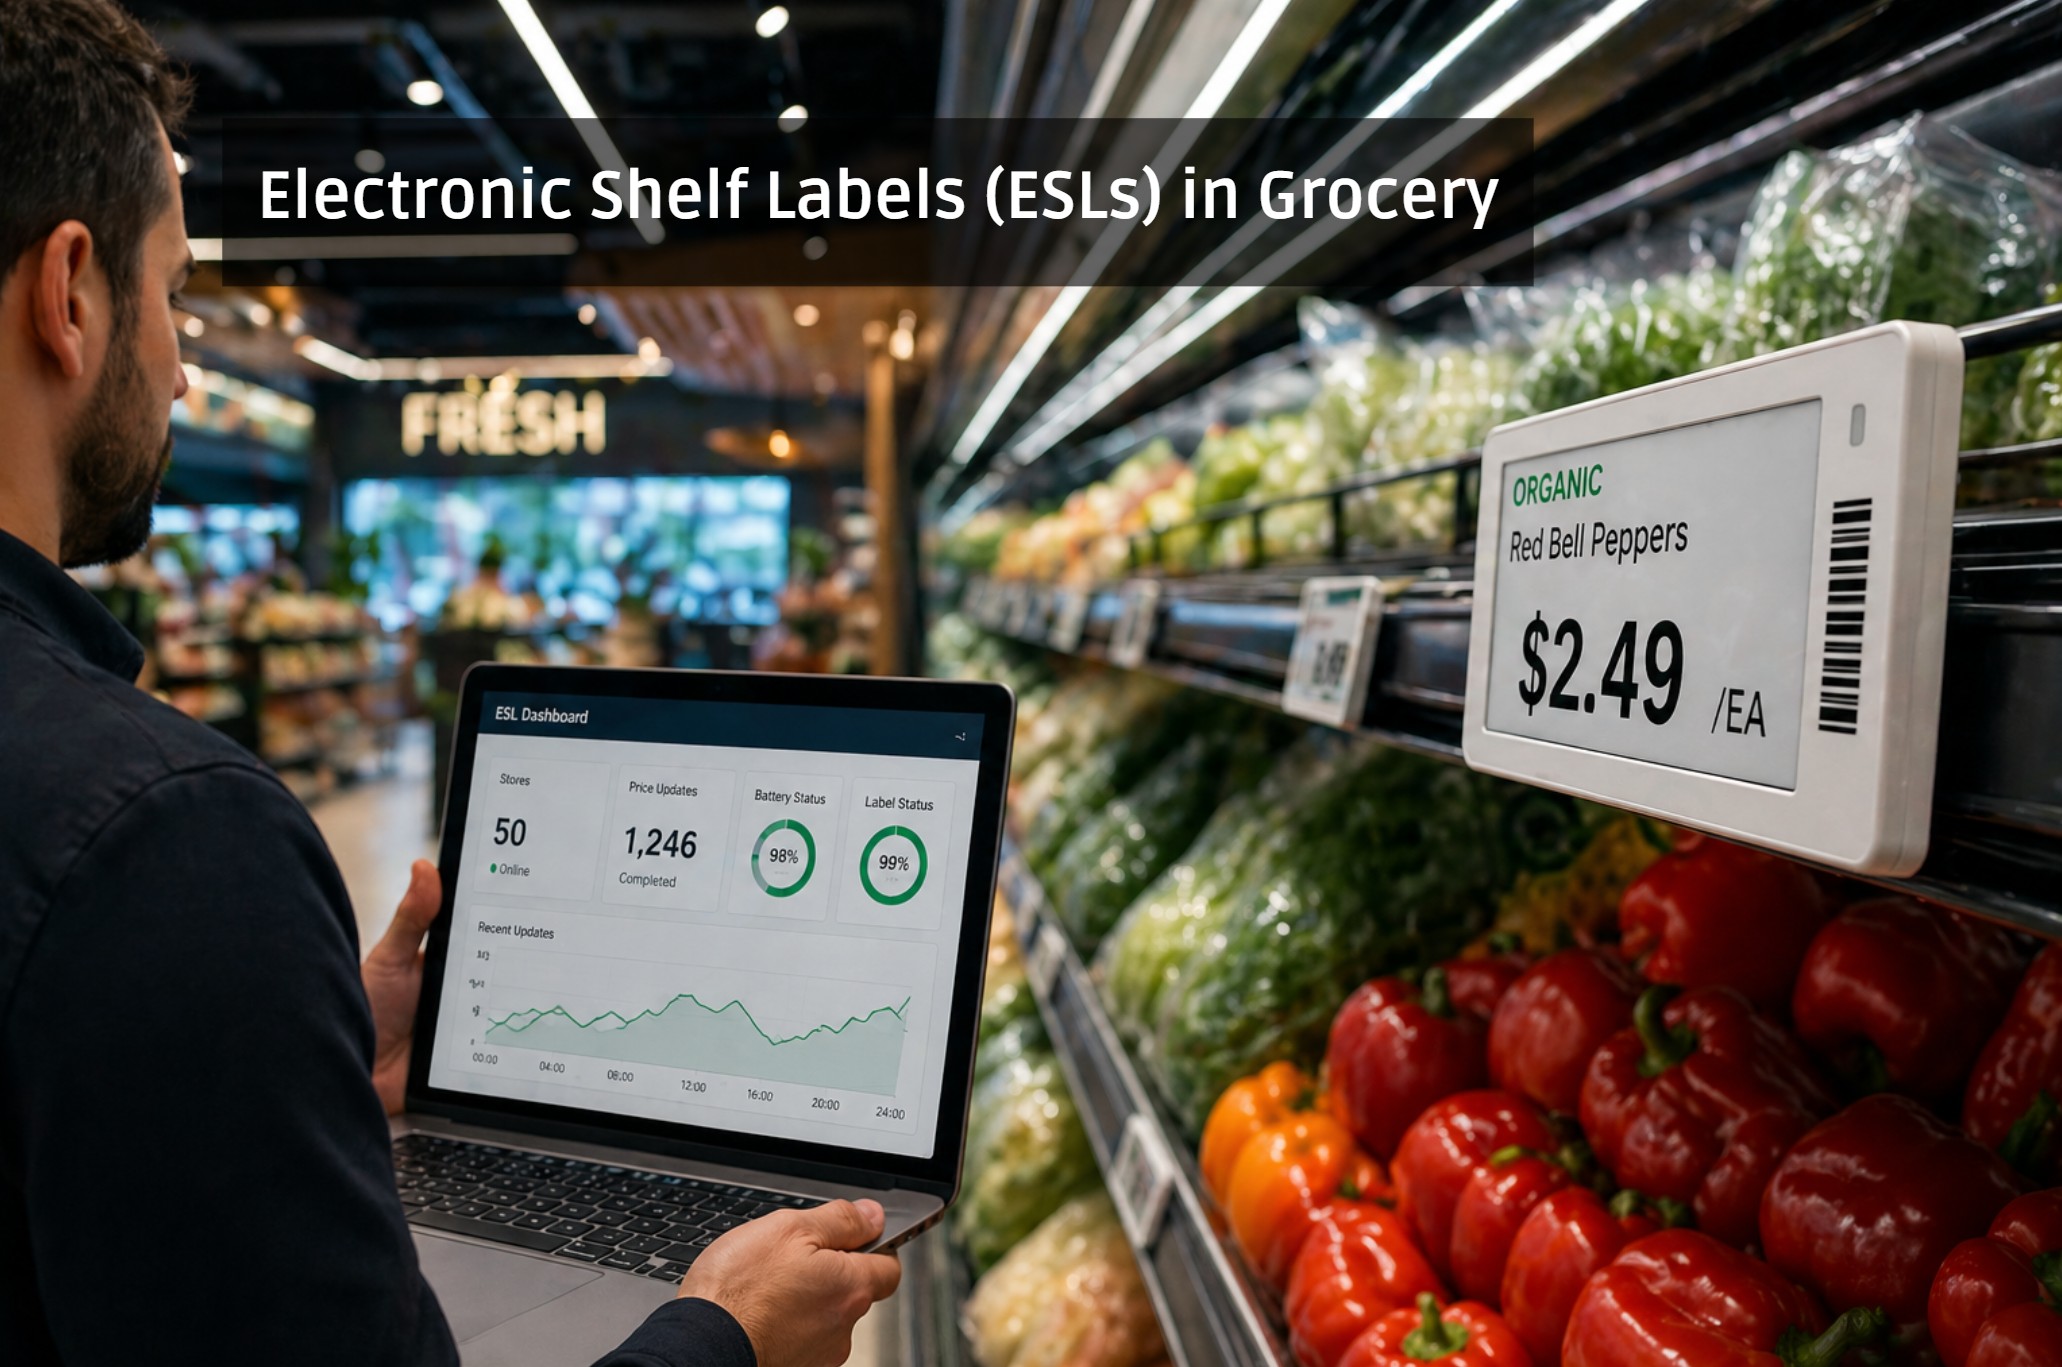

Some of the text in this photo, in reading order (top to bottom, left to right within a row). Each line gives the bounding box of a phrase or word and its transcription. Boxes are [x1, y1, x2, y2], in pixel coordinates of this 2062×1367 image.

[401, 392, 607, 457] FRESH
[1512, 464, 1604, 507] ORGANIC
[1509, 520, 1689, 566] Red Bell Peppers
[1518, 609, 1767, 738] $2.49 /EA
[495, 706, 589, 725] ESL Dashboard
[499, 772, 531, 787] Stores
[629, 780, 698, 799] Price Updates
[754, 788, 827, 806] Battery Status
[864, 795, 934, 812] Label Status
[493, 817, 528, 847] 50
[624, 826, 698, 860] 1,246
[769, 847, 799, 864] 98%
[879, 854, 910, 872] 99%
[499, 863, 531, 877] Online
[618, 872, 677, 889] Completed
[477, 920, 555, 940] Recent Updates
[681, 1079, 707, 1093] 12:00
[747, 1088, 774, 1102] 16:00
[811, 1097, 840, 1111] 20:00
[875, 1106, 906, 1121] 24:00
